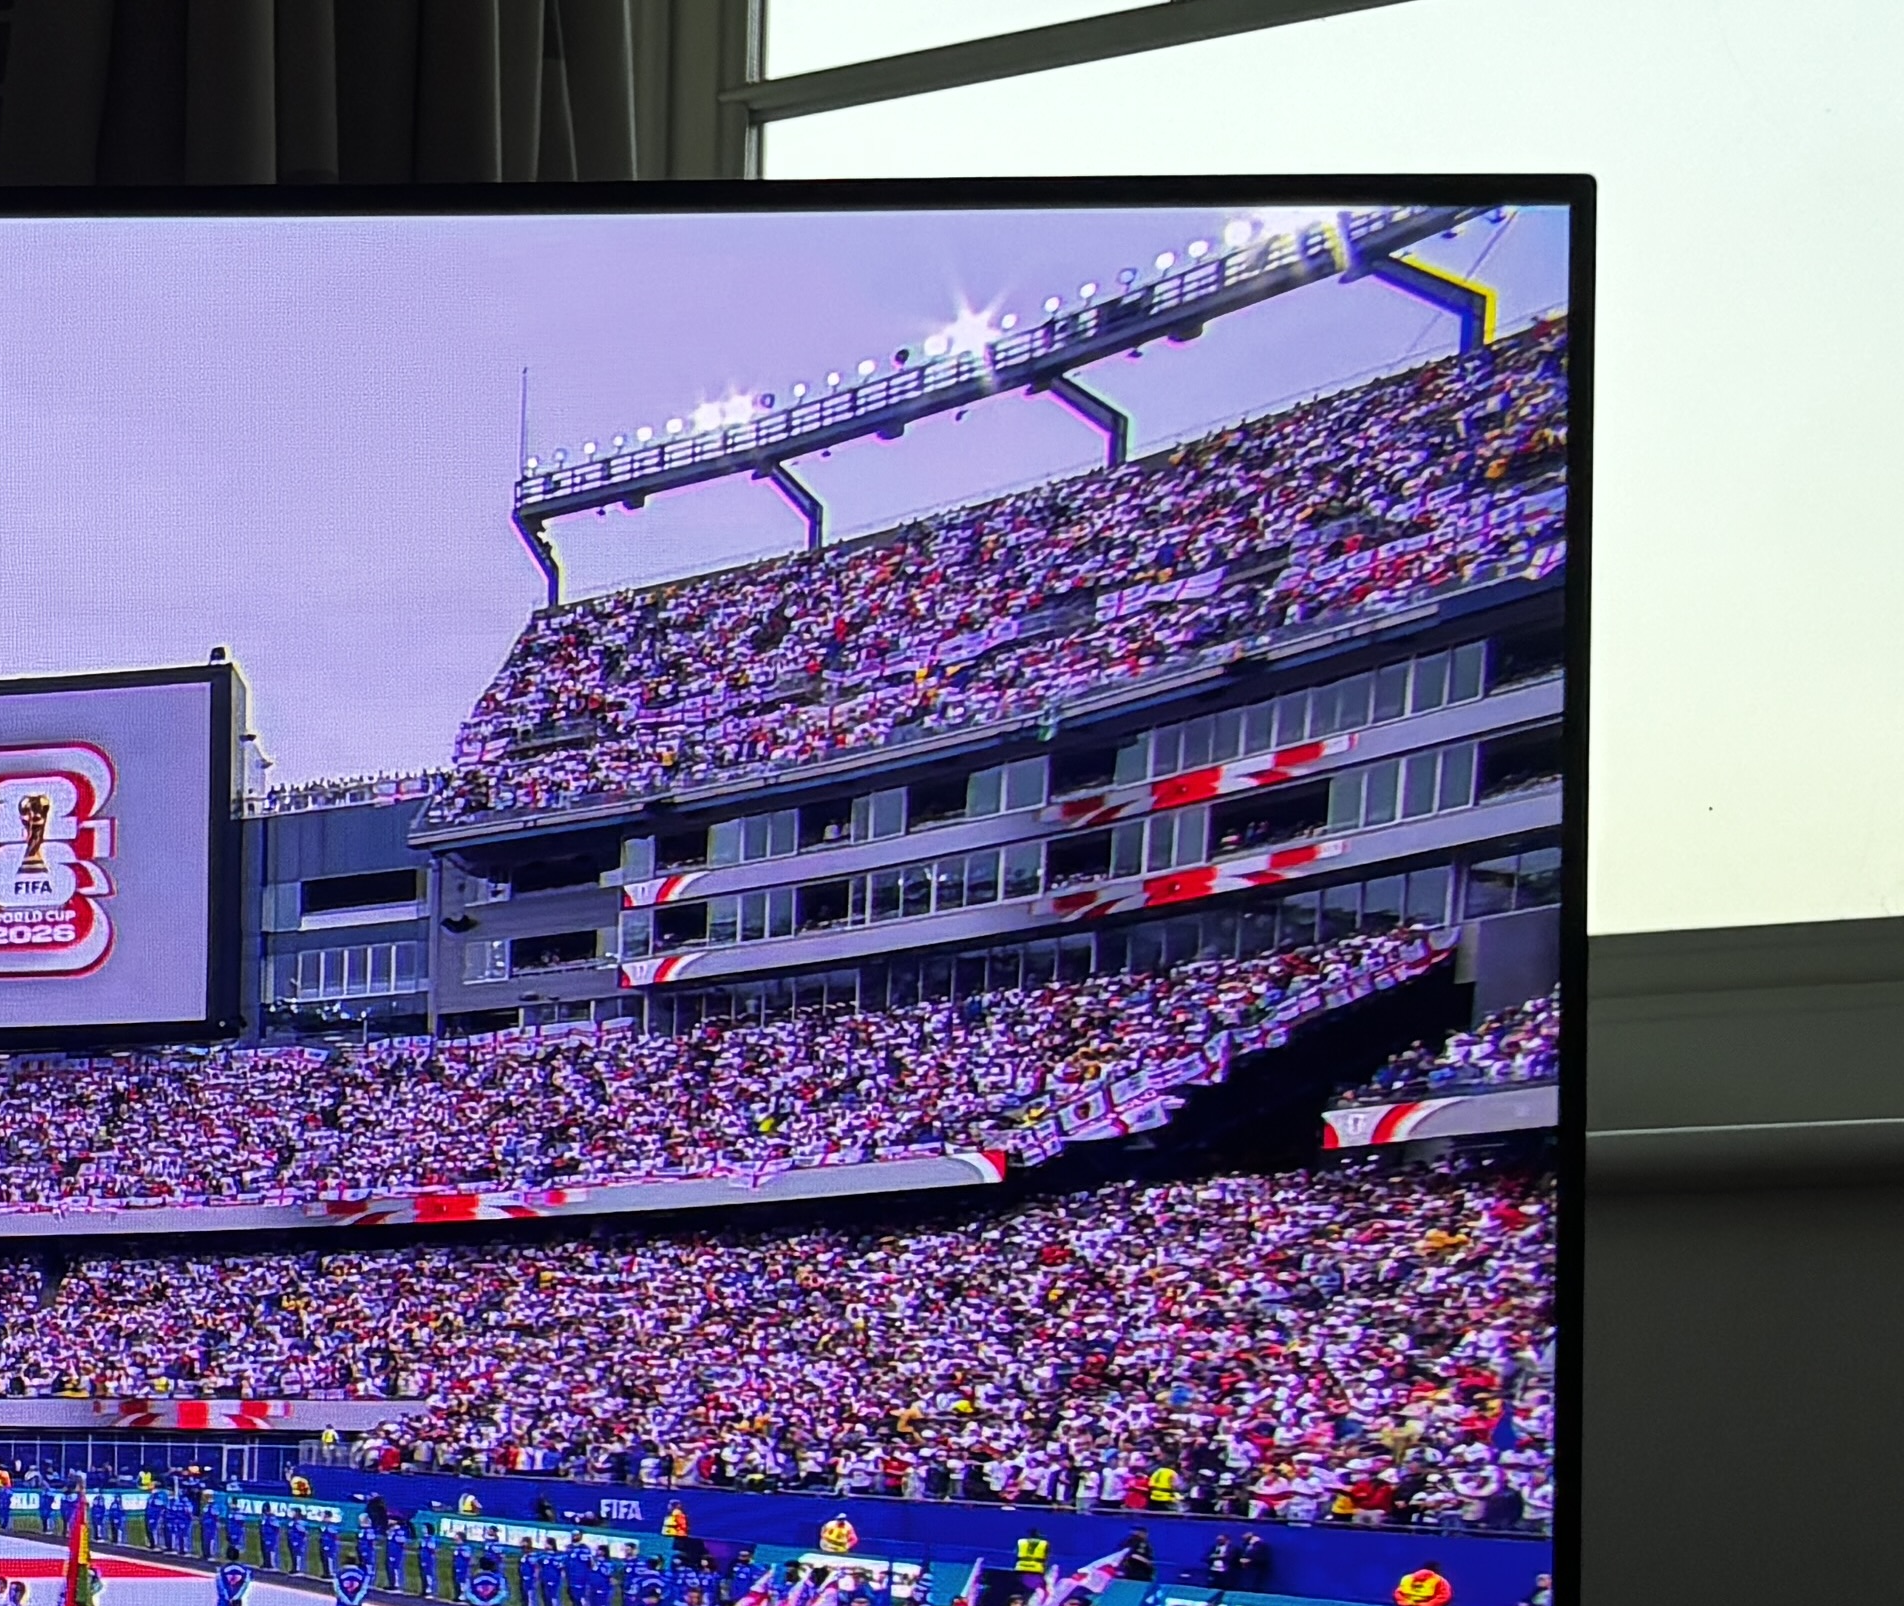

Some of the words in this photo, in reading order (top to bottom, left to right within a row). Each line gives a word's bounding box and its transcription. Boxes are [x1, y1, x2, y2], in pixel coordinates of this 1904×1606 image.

[14, 881, 52, 895] FIFA
[45, 910, 76, 922] CUP
[600, 1499, 643, 1520] FIFA
